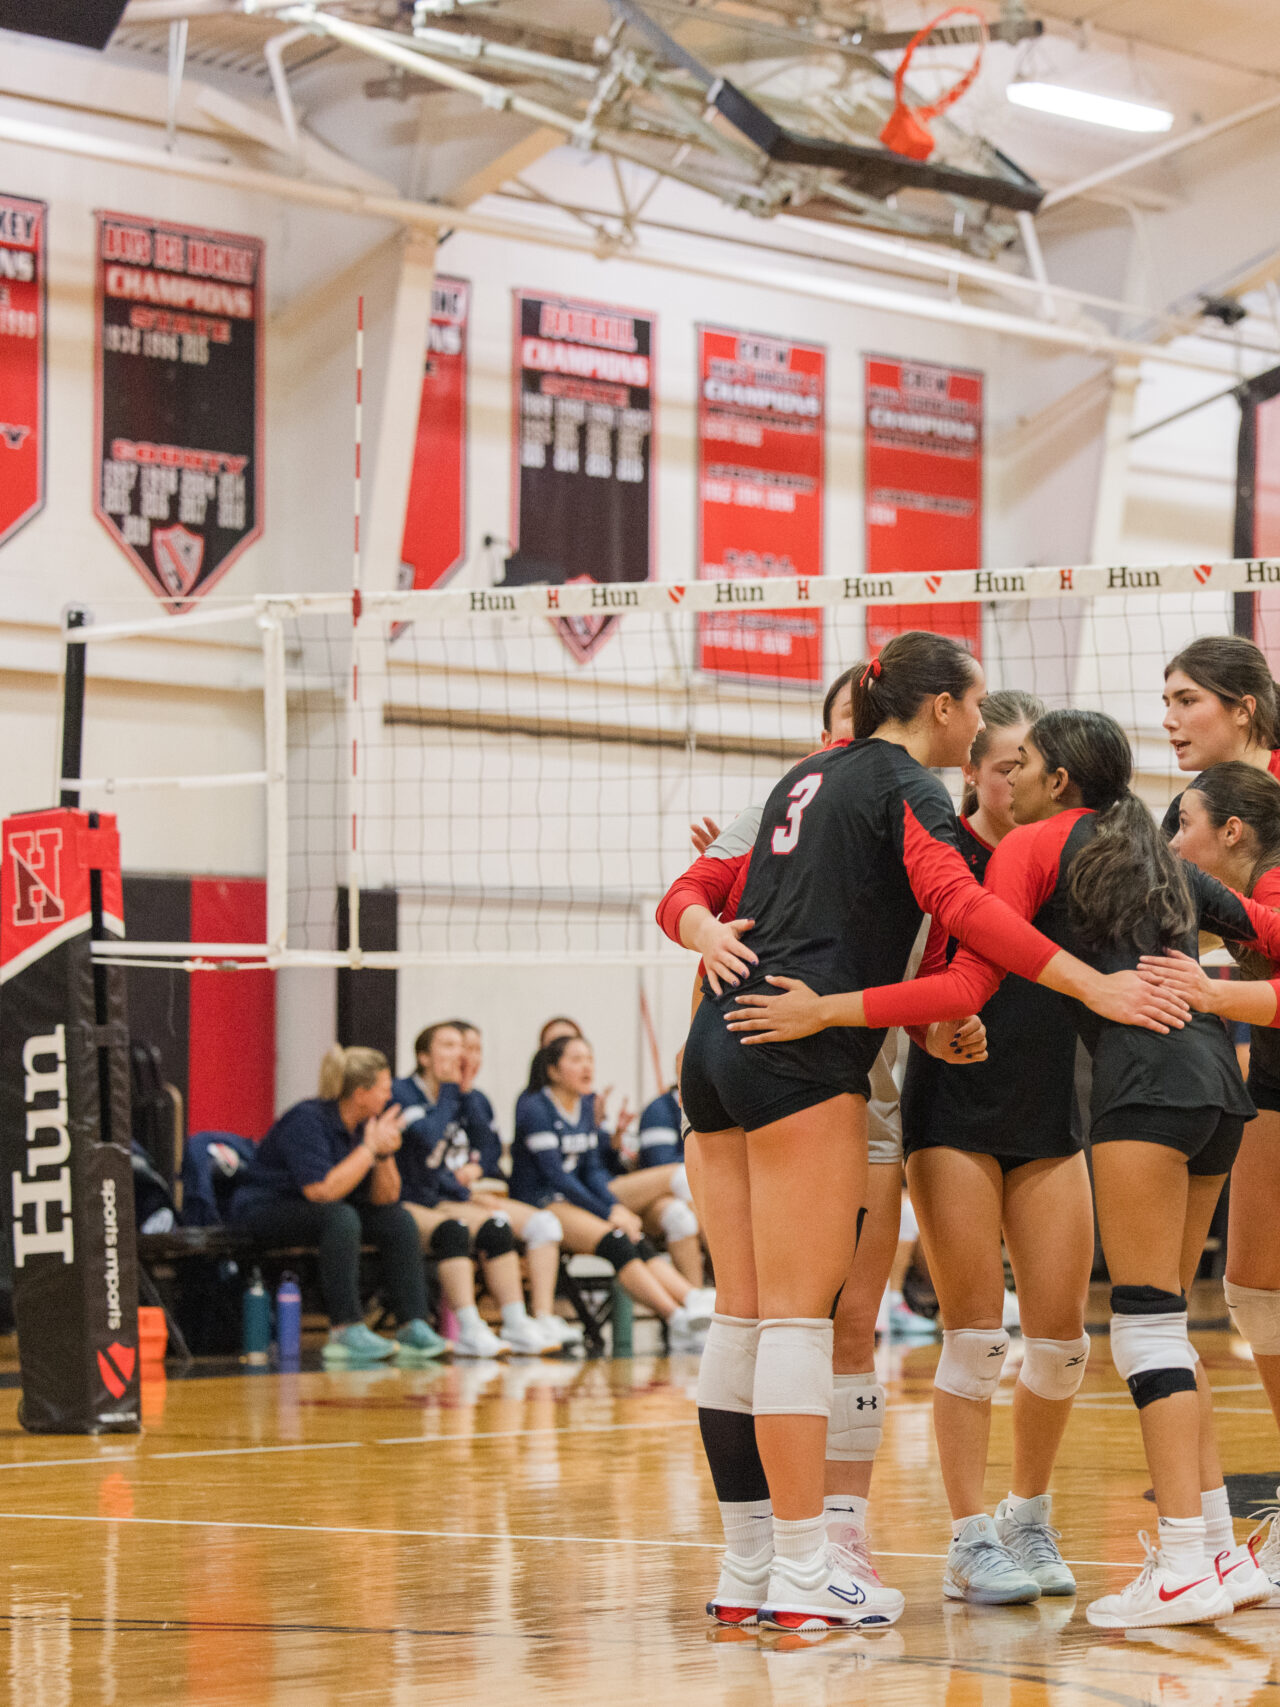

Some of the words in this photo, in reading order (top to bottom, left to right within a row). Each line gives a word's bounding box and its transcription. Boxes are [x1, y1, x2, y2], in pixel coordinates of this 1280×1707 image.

[105, 265, 253, 319] CHAMPIONS
[521, 335, 650, 388] CHAMPIONS
[470, 592, 516, 611] Hun
[547, 589, 559, 609] H
[592, 587, 639, 607] Hun
[716, 583, 764, 603] Hun
[797, 580, 809, 600] H
[844, 578, 893, 599] Hun
[973, 572, 1026, 593] Hun
[1060, 569, 1073, 590] H
[1107, 567, 1161, 589] Hun
[771, 772, 824, 856] 3
[11, 1023, 74, 1268] Hun
[101, 1179, 119, 1247] sports
[104, 1247, 122, 1331] imports
